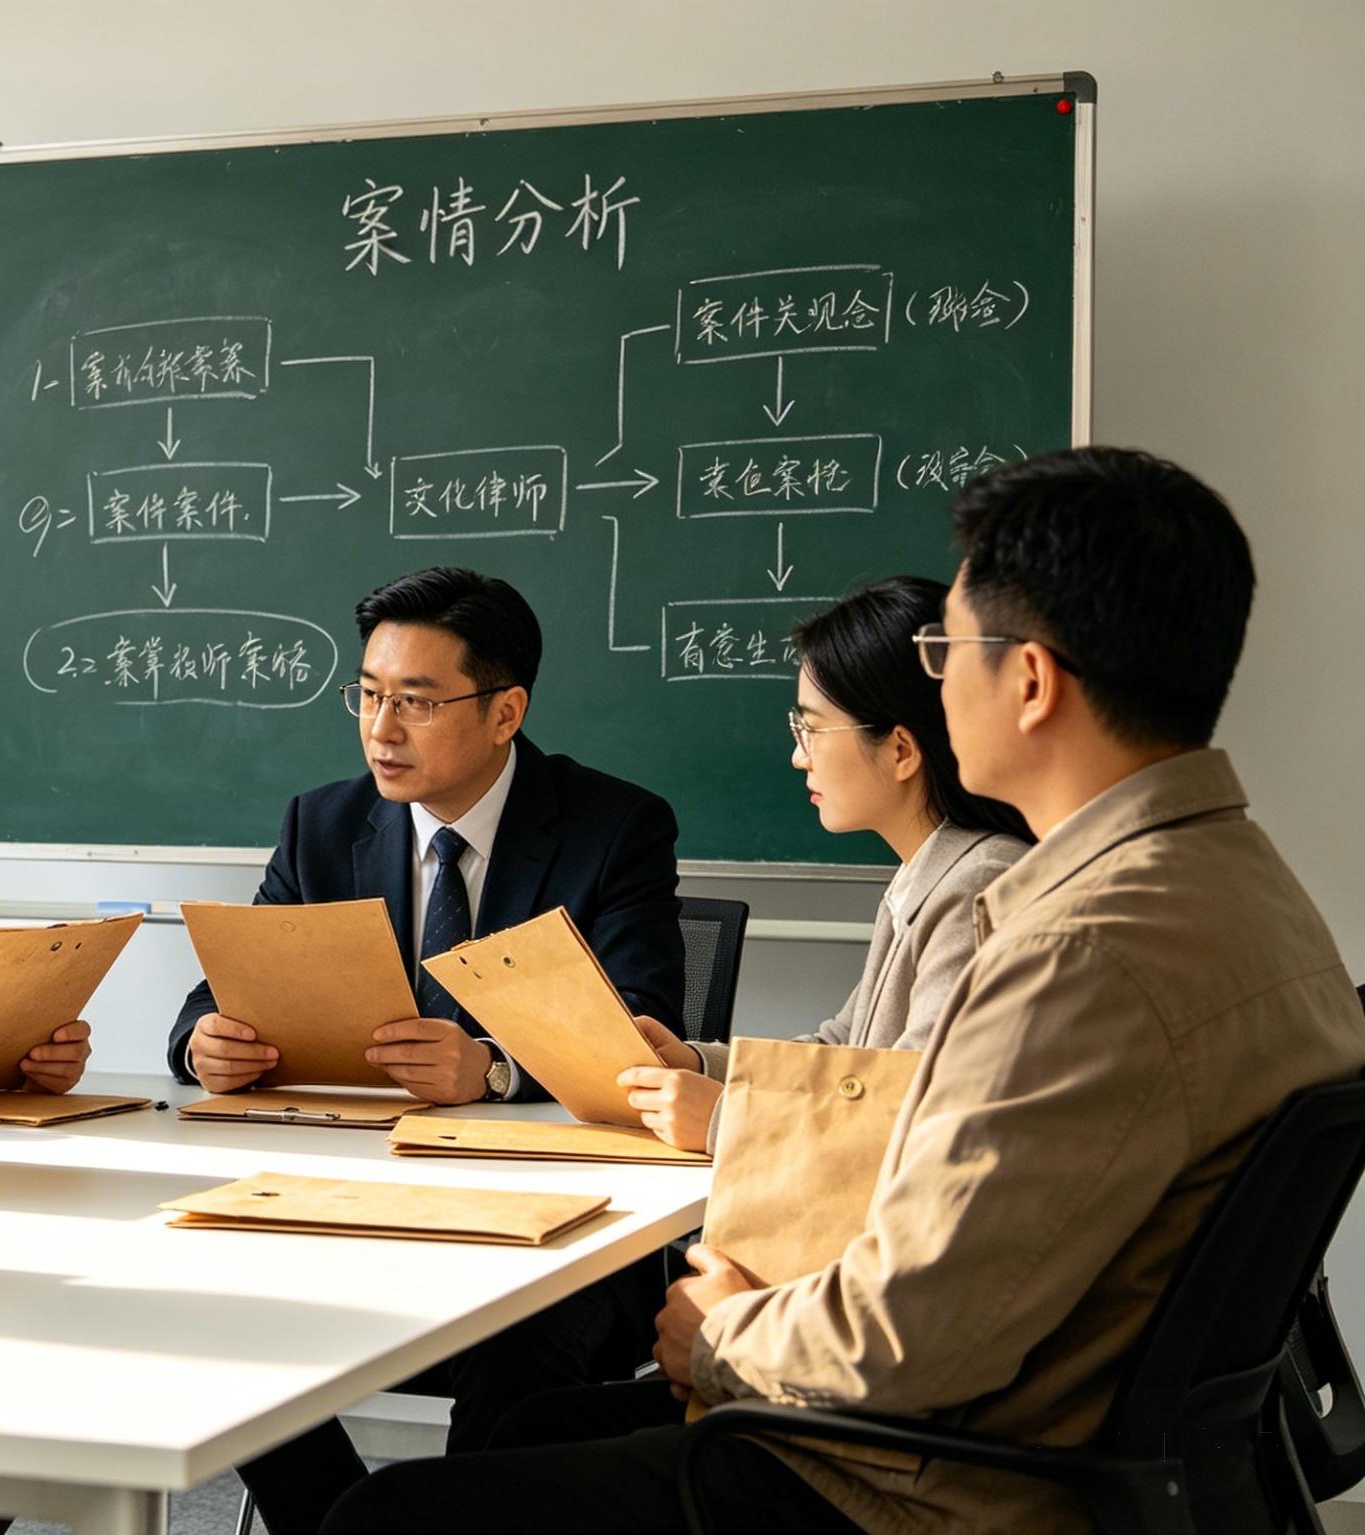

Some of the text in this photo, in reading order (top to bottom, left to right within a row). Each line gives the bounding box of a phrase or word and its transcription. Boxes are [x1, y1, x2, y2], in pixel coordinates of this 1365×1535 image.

[342, 174, 641, 276] 案情分析
[404, 470, 548, 522] 文化律师
